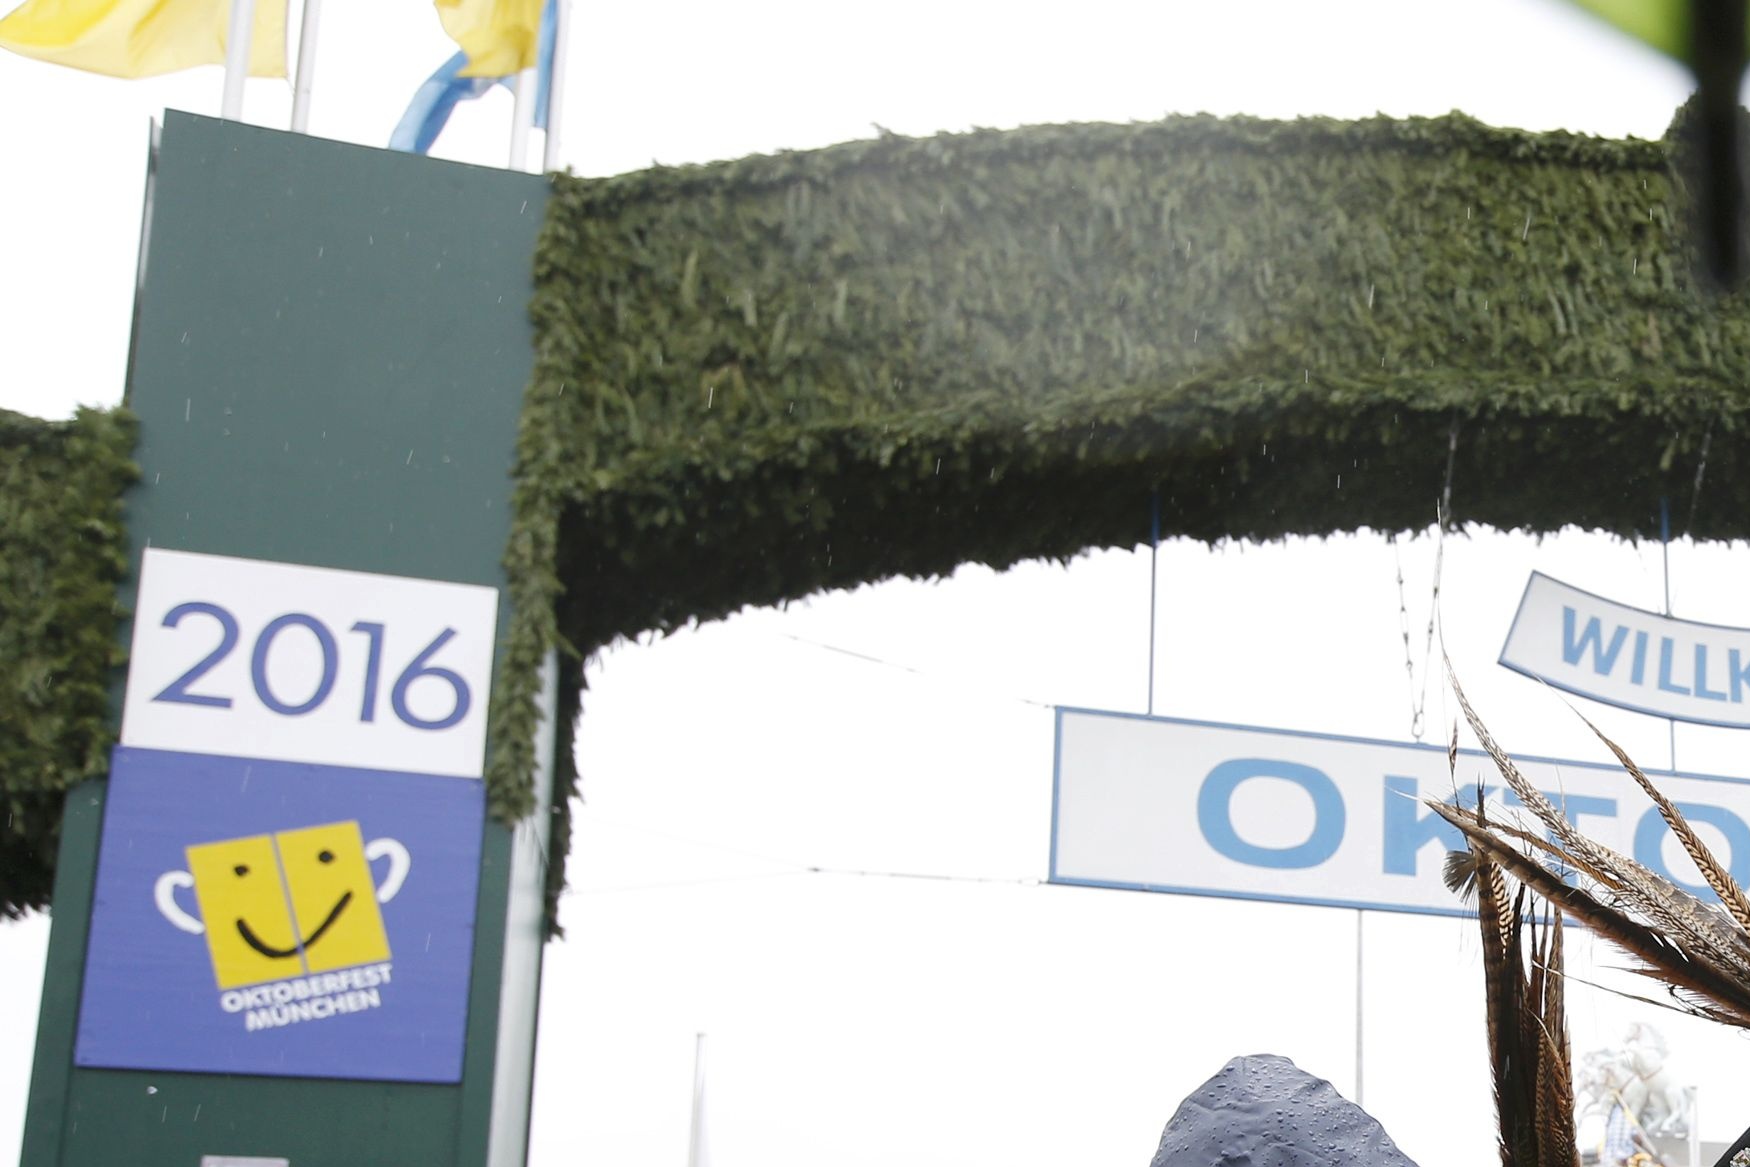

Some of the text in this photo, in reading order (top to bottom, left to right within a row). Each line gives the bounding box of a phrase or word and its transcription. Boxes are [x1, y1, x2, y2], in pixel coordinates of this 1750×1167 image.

[149, 601, 472, 731] 2016
[220, 963, 392, 1014] OKTOBERFEST
[244, 988, 381, 1031] MÜNCHEN
